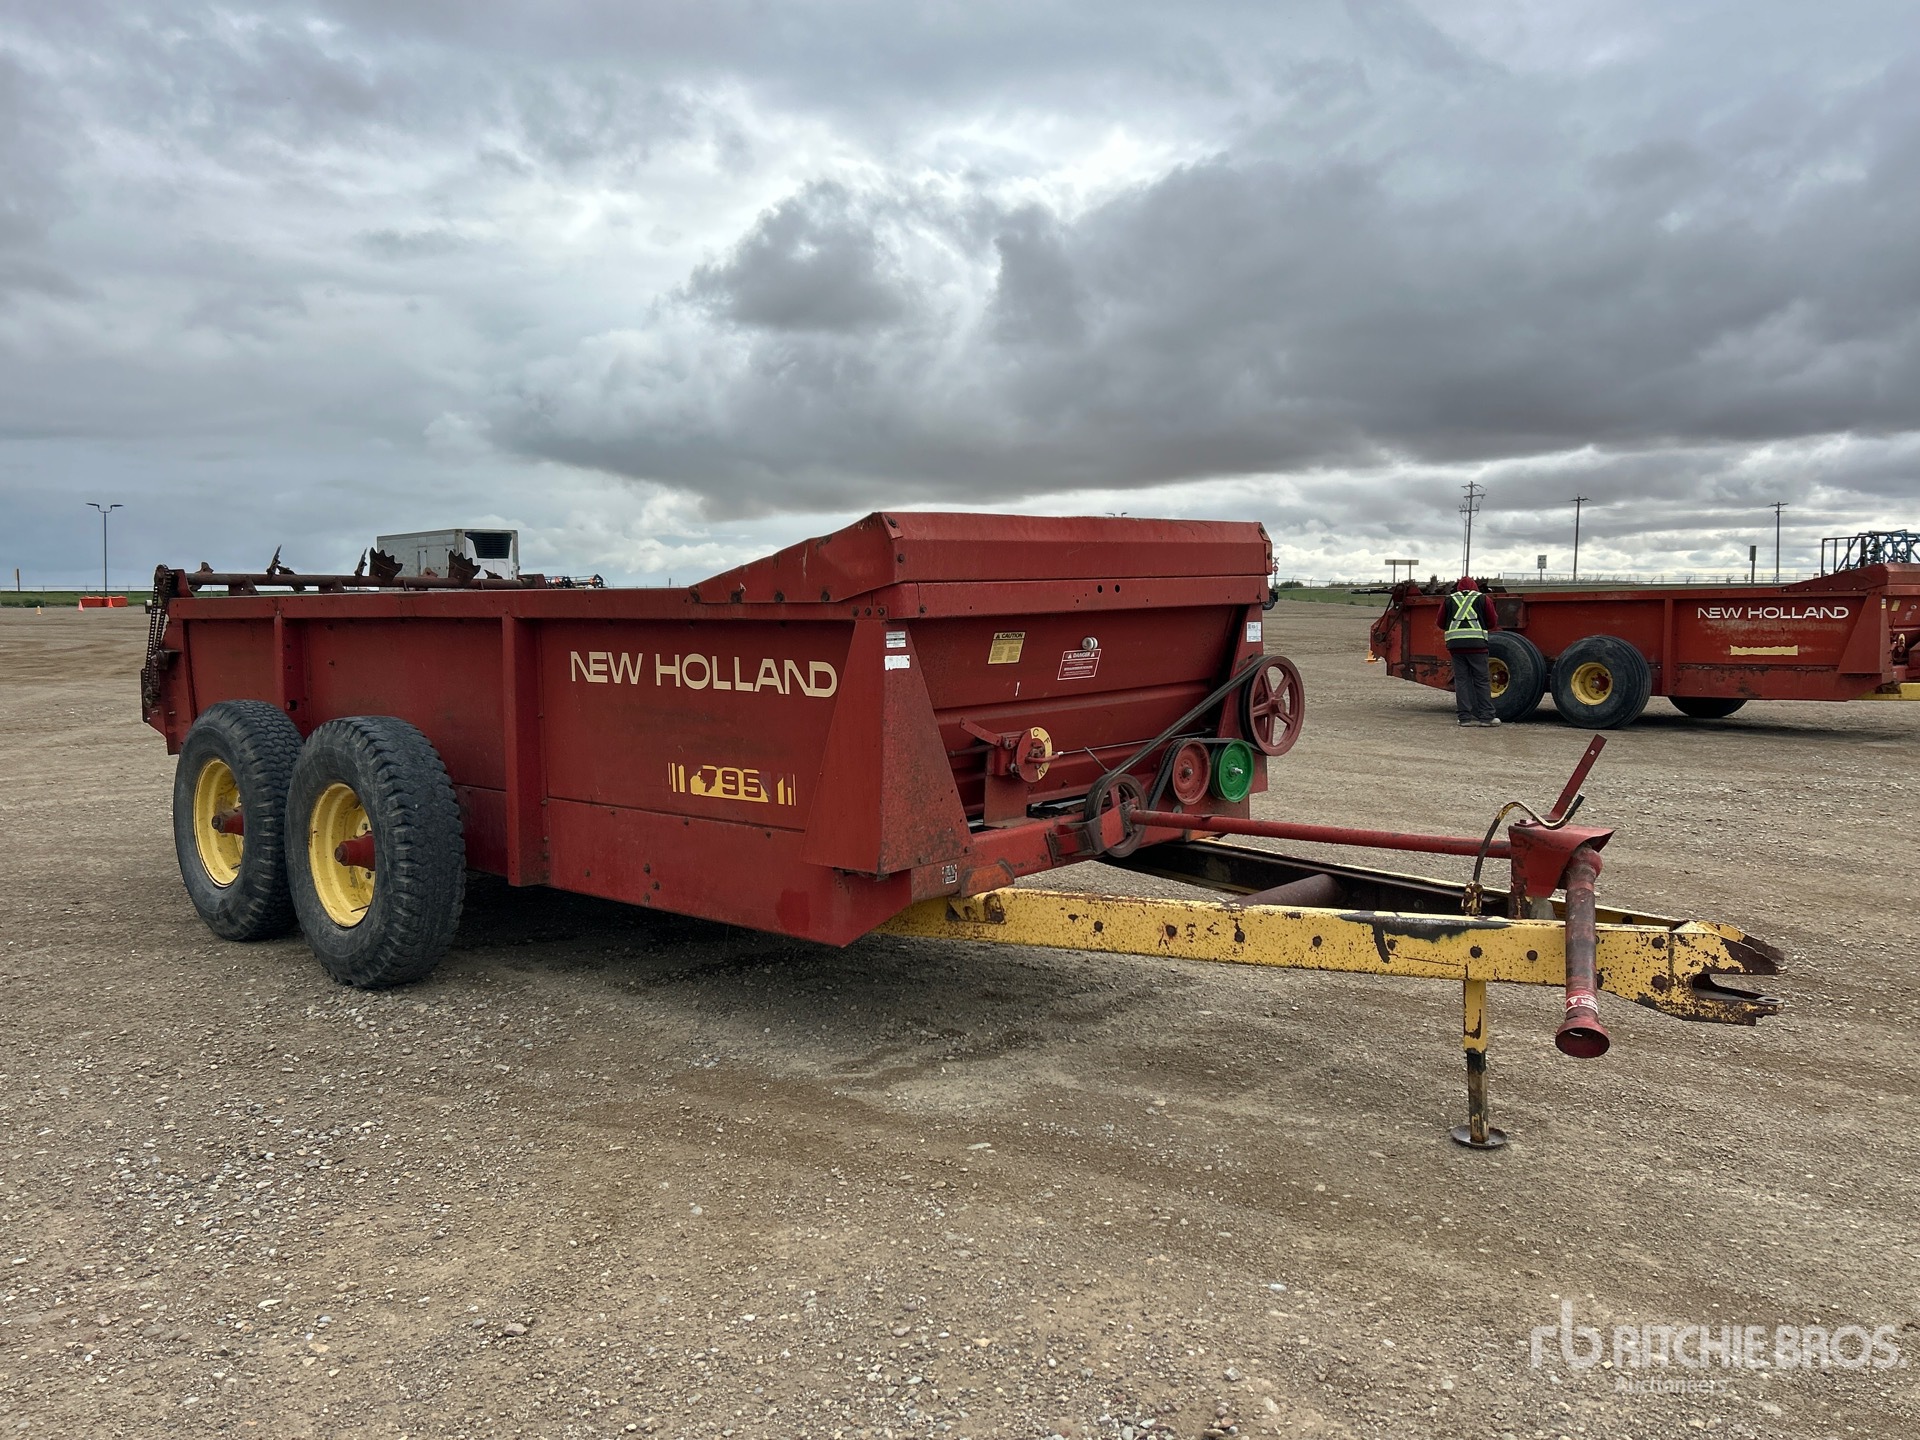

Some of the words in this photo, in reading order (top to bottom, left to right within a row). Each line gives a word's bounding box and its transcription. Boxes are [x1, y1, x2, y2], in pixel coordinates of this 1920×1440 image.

[1697, 607, 1743, 619] NEW
[1748, 606, 1849, 619] HOLLAND
[570, 651, 643, 684] NEW
[655, 653, 838, 698] HOLLAND
[700, 766, 763, 799] 795
